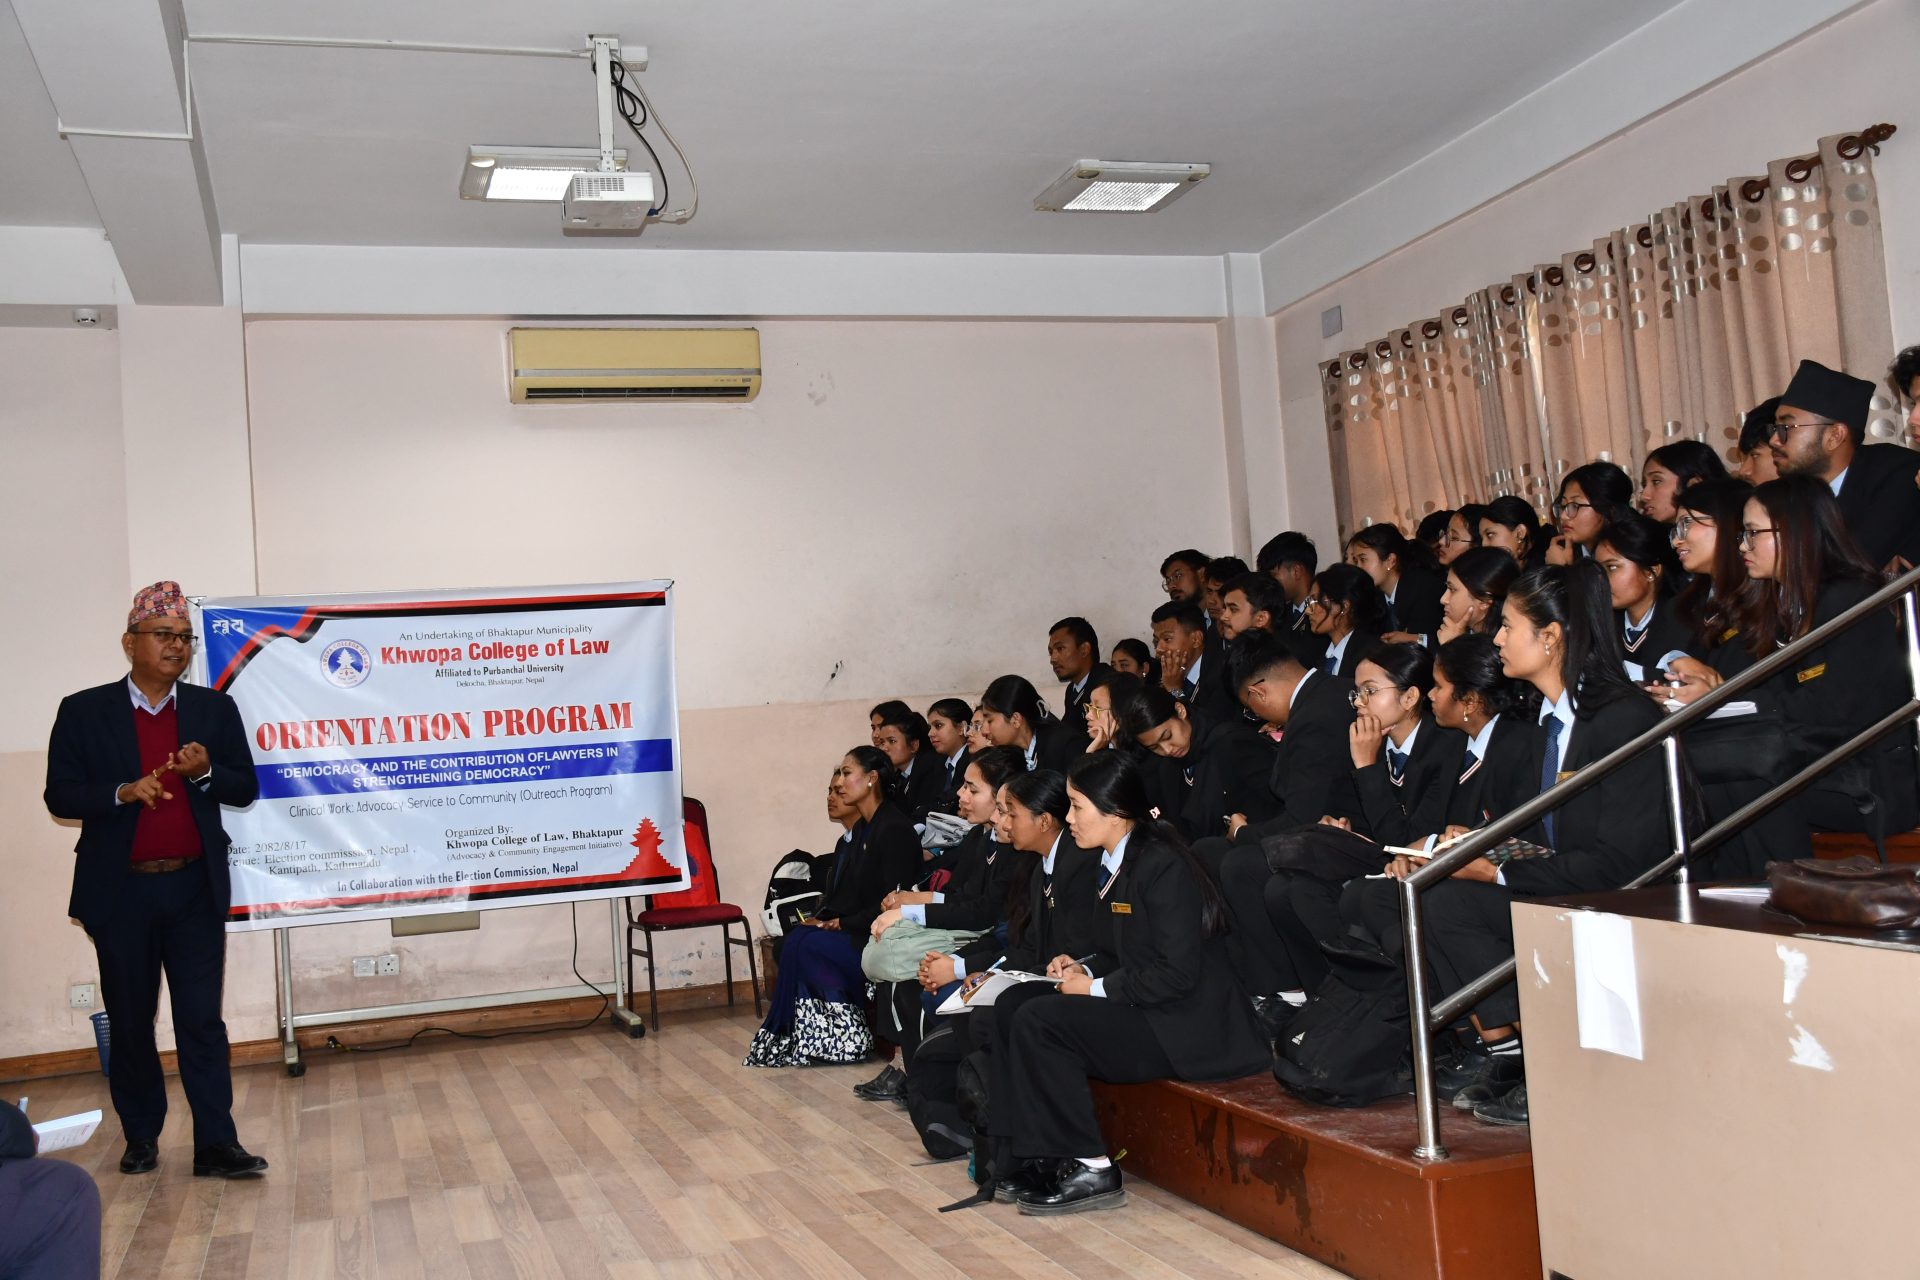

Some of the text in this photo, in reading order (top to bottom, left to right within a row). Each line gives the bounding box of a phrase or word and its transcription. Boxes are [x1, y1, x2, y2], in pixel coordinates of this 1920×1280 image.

[399, 624, 593, 641] An Undertaking of Bhaktapur Municipality
[381, 638, 610, 666] Khwopa College of Law
[435, 663, 564, 678] Affiliated to Purbanchal University
[525, 676, 545, 685] Nepal
[256, 702, 633, 752] ORIENTATION PROGRAM
[371, 761, 399, 773] AND
[402, 759, 427, 770] THE
[430, 753, 525, 769] CONTRIBUTION
[606, 747, 619, 758] IN
[352, 772, 462, 788] STRENGTHENING
[289, 784, 613, 818] Clinical Work: Advocacy Service to Community (Outreach Program)
[445, 824, 514, 840] Organized By:
[446, 828, 624, 850] Khwopa College of Law, Bhaktapur
[255, 840, 307, 853] 2082/8/17
[265, 853, 306, 864] Election
[380, 843, 409, 856] Nepal
[446, 839, 623, 862] (Advocacy & Community Engagement Initiative)
[269, 863, 321, 876] Kantipath,
[338, 861, 579, 891] In Collaboration with the Election Commission, Nepal
